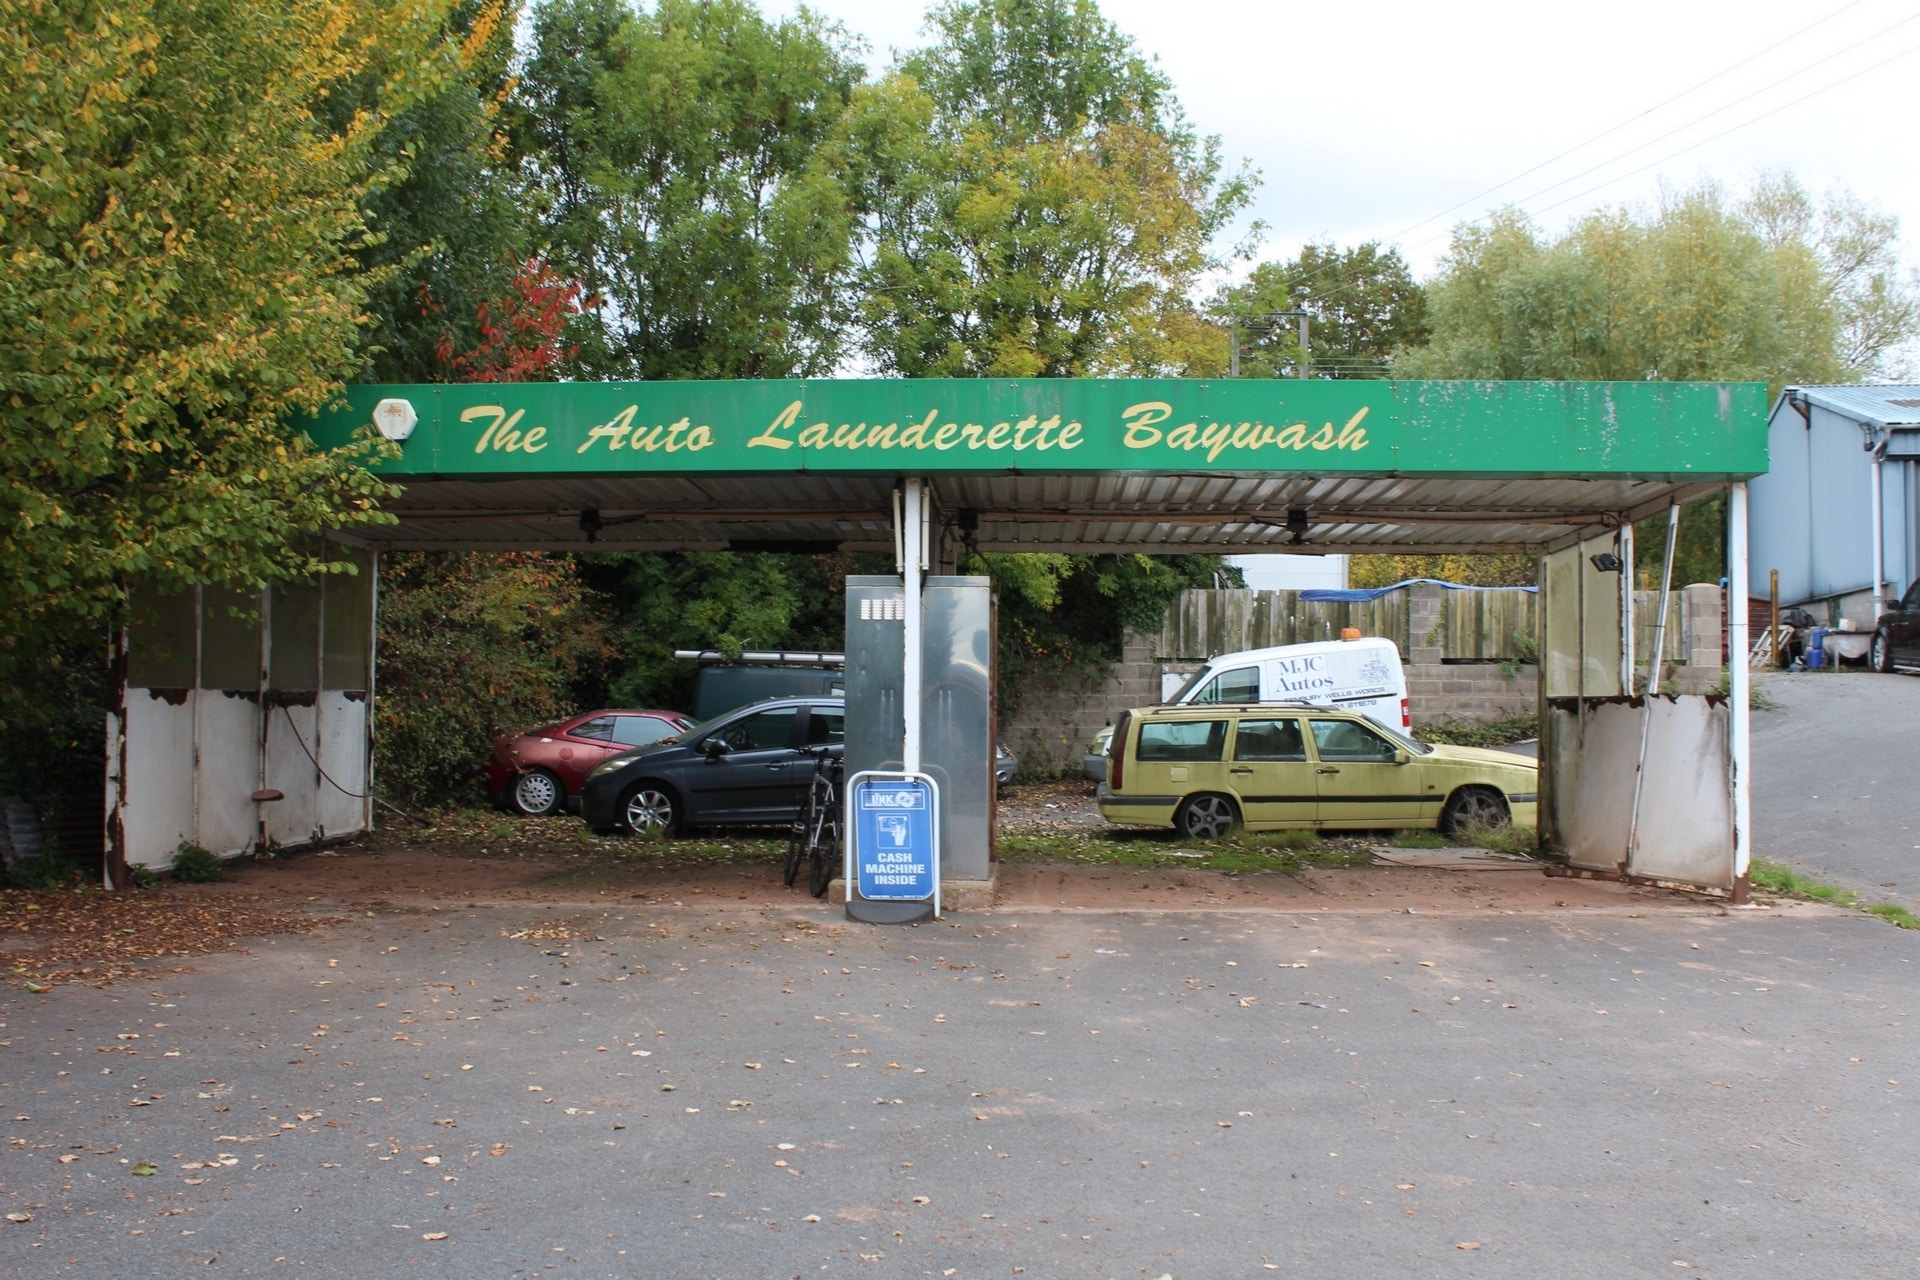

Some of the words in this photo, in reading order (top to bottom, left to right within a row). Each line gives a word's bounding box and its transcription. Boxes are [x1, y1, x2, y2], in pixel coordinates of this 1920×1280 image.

[460, 405, 548, 453] The
[577, 404, 715, 453] Auto
[747, 400, 1085, 451] Launderette
[1121, 401, 1370, 463] Baywash
[1280, 656, 1324, 675] MJC
[1276, 675, 1334, 693] Autos
[877, 852, 912, 862] CASH
[865, 863, 925, 874] MACHINE
[874, 874, 917, 885] INSIDE
